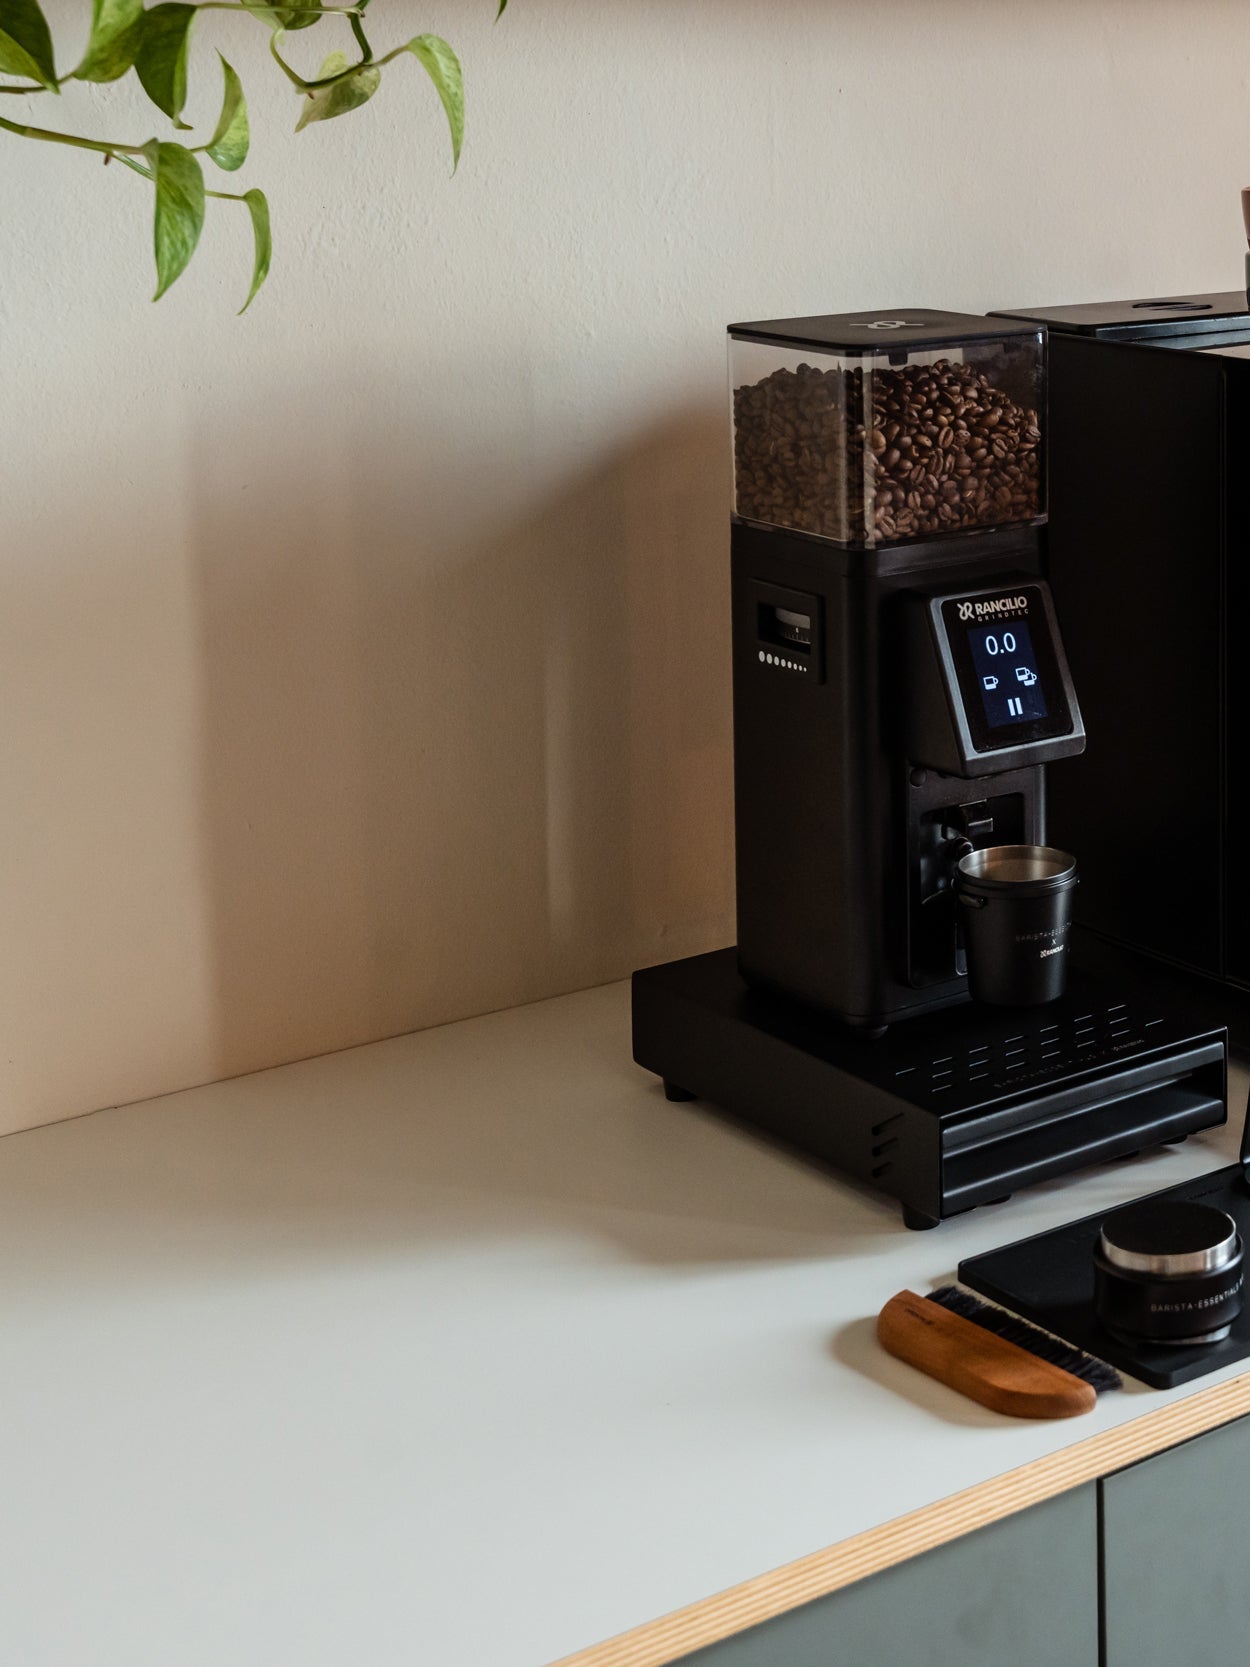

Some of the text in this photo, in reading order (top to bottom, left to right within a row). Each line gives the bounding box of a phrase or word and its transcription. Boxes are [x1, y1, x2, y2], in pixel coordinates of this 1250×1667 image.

[974, 596, 1028, 616] RANCILIO
[977, 608, 1030, 622] GRINDTEC
[985, 632, 1017, 655] 0.0
[1150, 1281, 1240, 1313] BARISTA-ESSENTIALS
